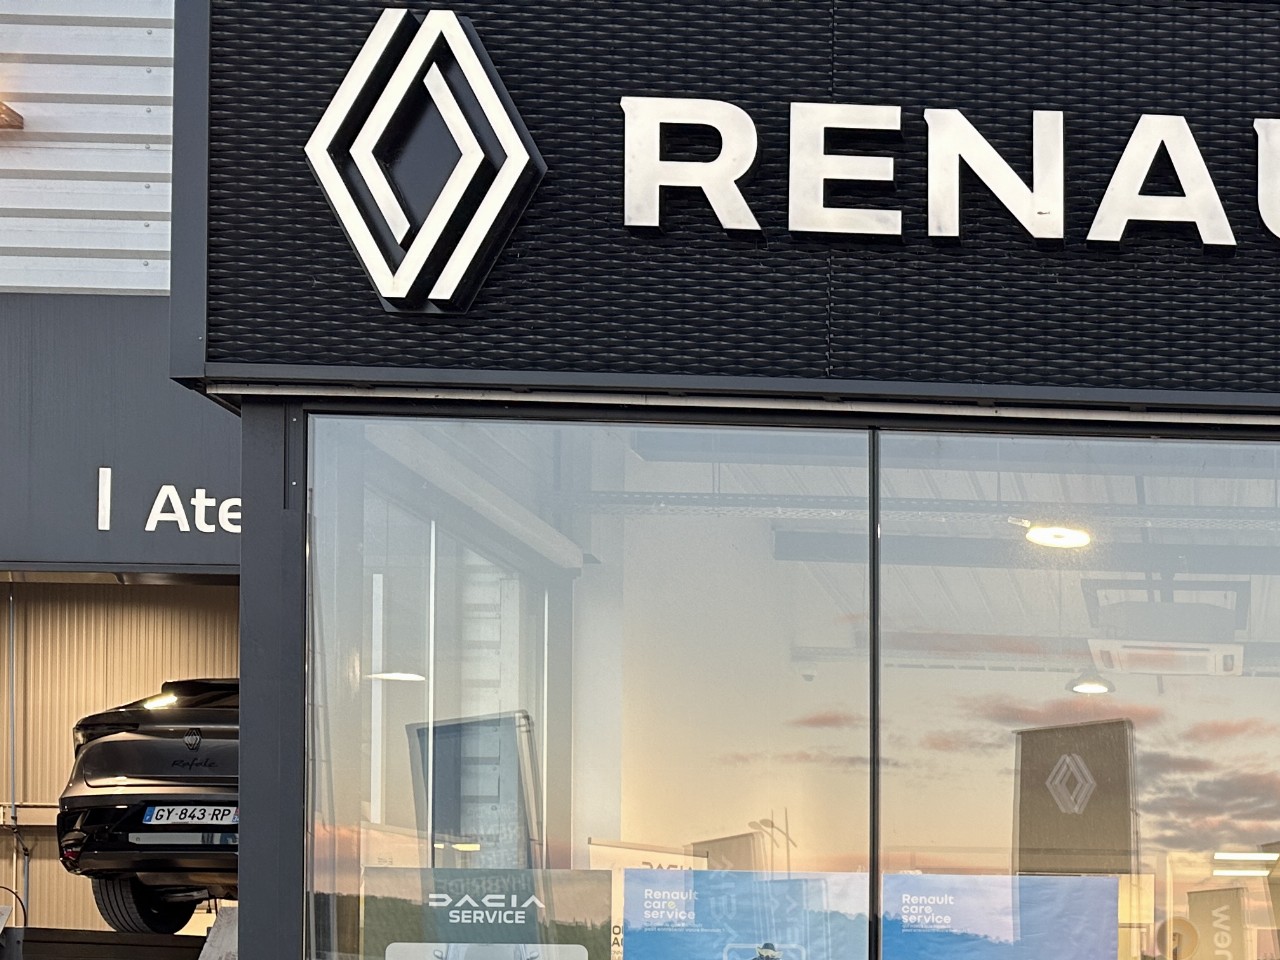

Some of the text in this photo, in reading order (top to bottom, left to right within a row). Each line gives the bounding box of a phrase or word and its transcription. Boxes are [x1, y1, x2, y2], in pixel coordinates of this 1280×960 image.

[171, 758, 218, 769] Rafale
[155, 808, 231, 821] GY-843-RP
[644, 889, 699, 900] Renault
[902, 894, 954, 905] Renault
[428, 893, 545, 908] DACIA
[644, 900, 676, 909] care
[644, 909, 695, 920] service
[902, 905, 933, 914] care
[449, 910, 526, 924] SERVICE
[902, 914, 951, 924] service
